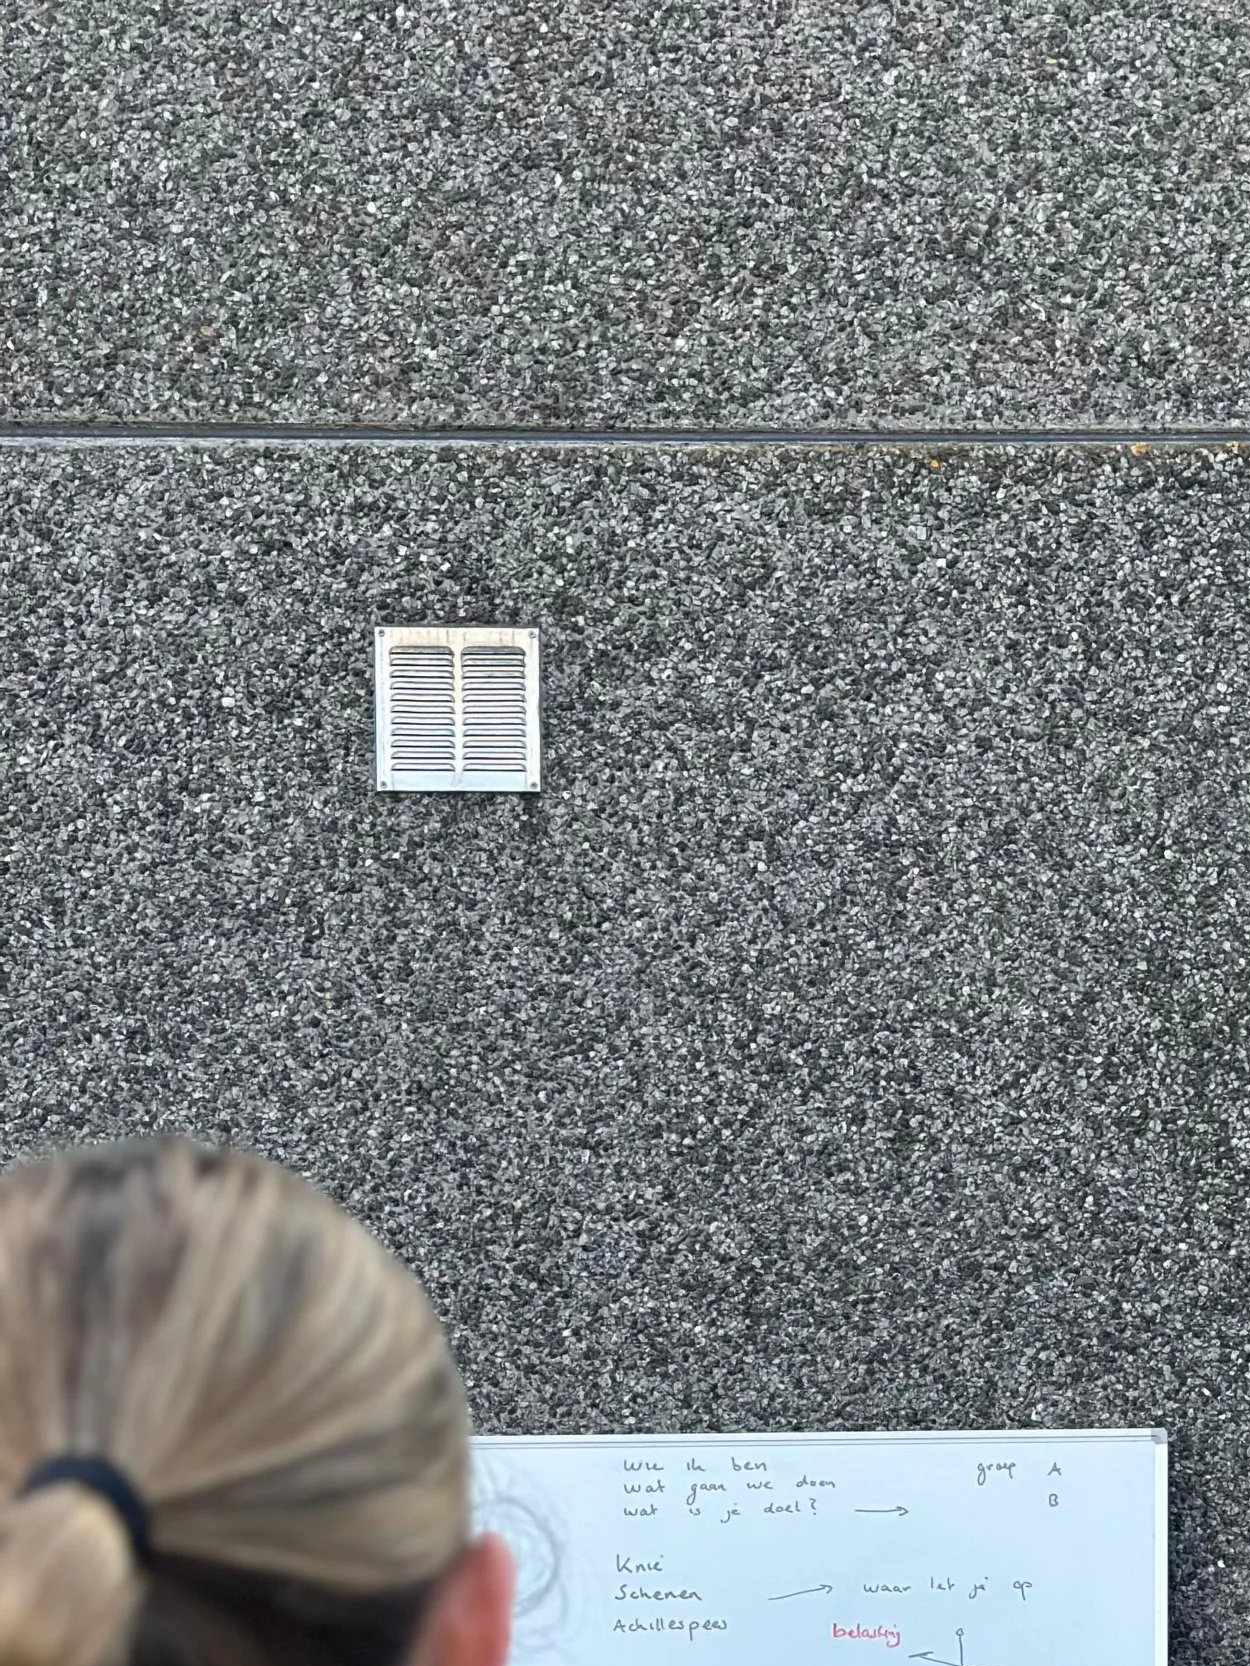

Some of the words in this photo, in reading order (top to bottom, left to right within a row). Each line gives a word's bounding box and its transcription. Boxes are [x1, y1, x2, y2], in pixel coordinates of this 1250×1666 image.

[731, 1456, 768, 1472] ben
[976, 1462, 1017, 1487] groep
[1047, 1461, 1062, 1477] A
[685, 1483, 727, 1506] gaan
[746, 1480, 774, 1490] we
[795, 1474, 836, 1489] doen
[1048, 1492, 1059, 1508] B
[688, 1507, 702, 1516] is
[719, 1502, 741, 1524] je
[616, 1553, 664, 1574] Knie
[614, 1583, 703, 1601] Schenen
[863, 1583, 912, 1594] waar
[930, 1576, 956, 1591] let
[1012, 1580, 1033, 1602] op
[612, 1617, 728, 1642] Achillespees
[832, 1622, 901, 1648] belasting
